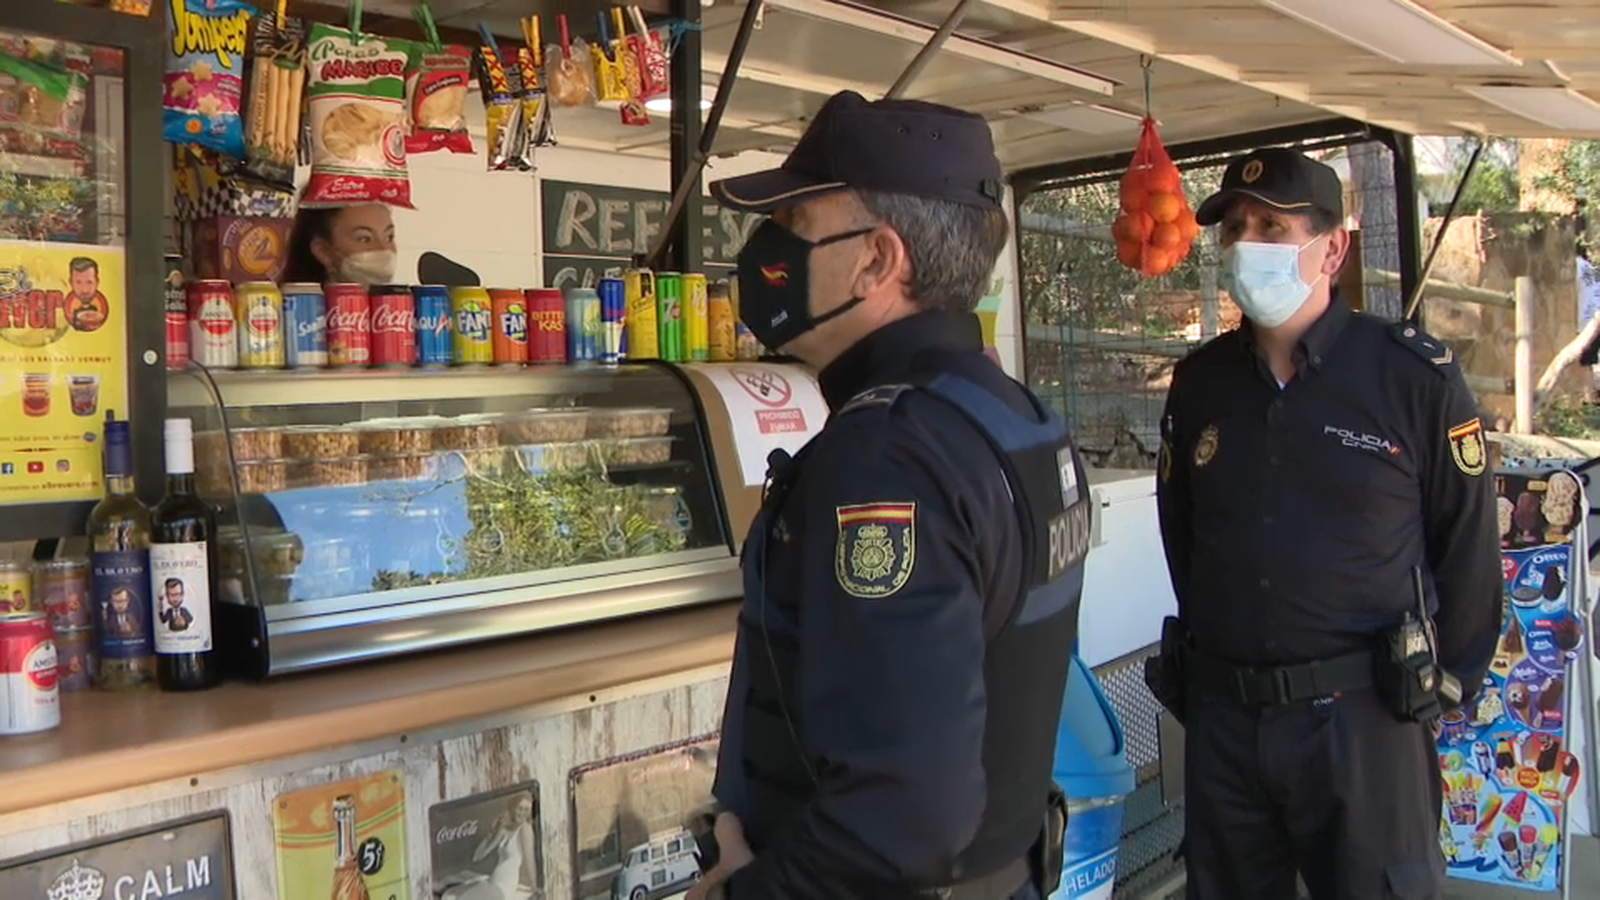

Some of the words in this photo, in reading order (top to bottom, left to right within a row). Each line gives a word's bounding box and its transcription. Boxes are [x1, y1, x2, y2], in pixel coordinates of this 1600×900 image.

[1323, 425, 1391, 450] POLICIA
[436, 819, 478, 844] Coca-Cola
[114, 855, 210, 900] CALM
[1064, 855, 1117, 896] HELADO
